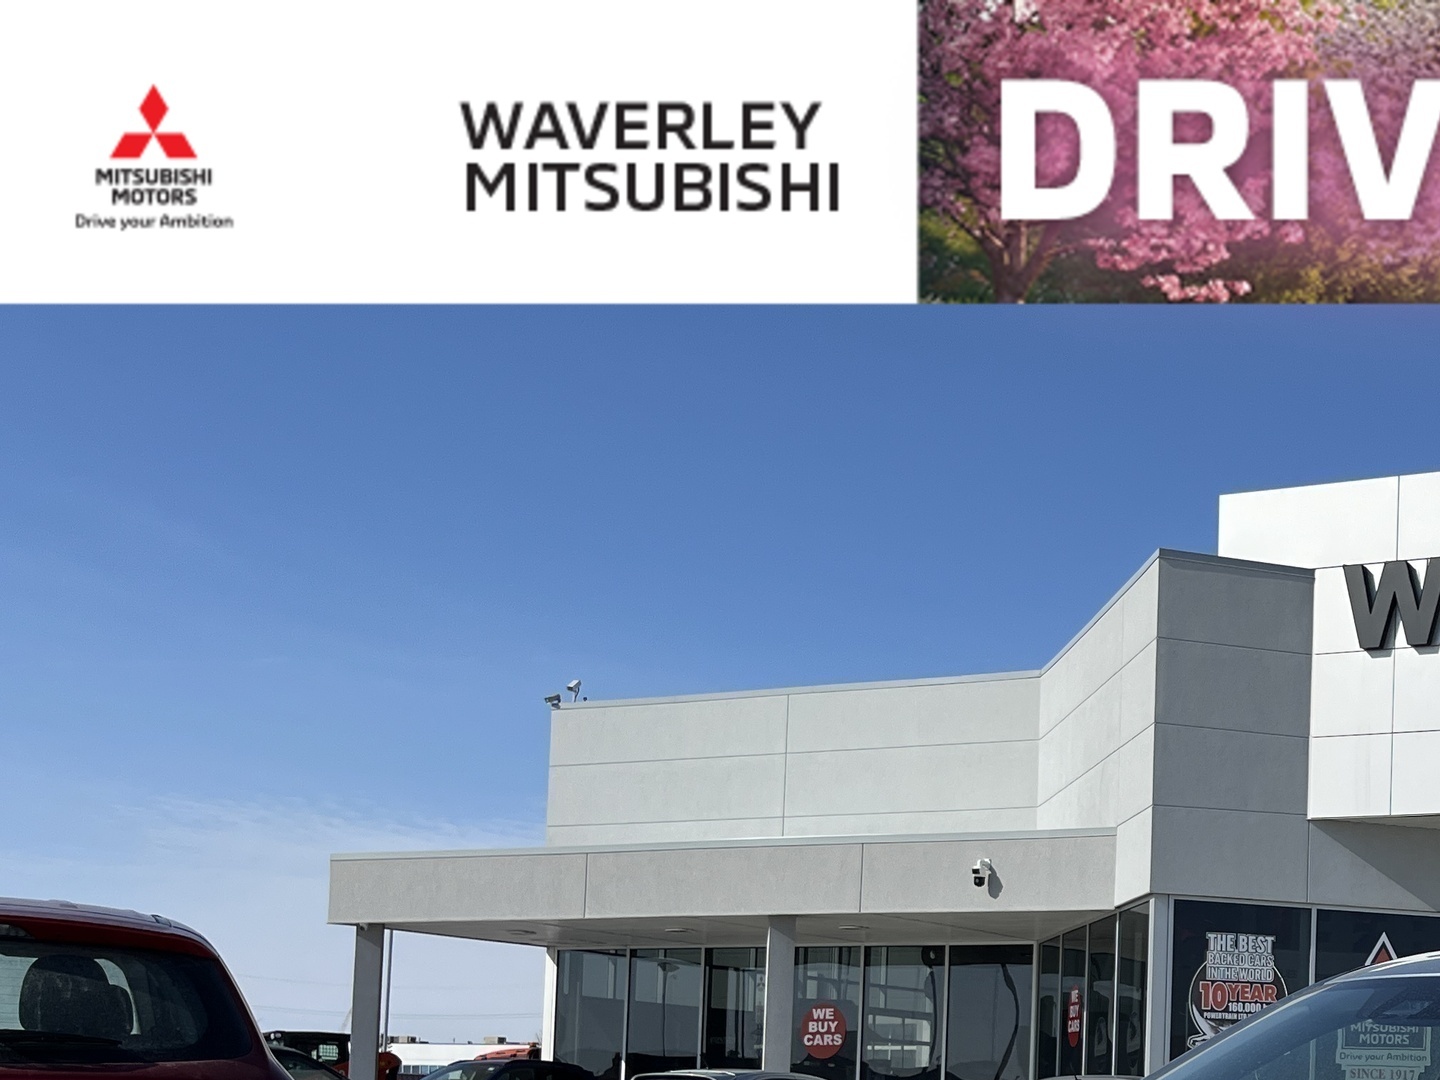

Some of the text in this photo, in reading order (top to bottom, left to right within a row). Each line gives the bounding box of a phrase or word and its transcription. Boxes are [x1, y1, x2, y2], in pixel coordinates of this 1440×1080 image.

[1207, 933, 1275, 955] THE BEST
[1207, 951, 1274, 967] BACKED CARS
[1208, 966, 1274, 982] IN THE WORLD
[1200, 981, 1277, 1011] 10 YEAR
[812, 1008, 835, 1020] WE
[808, 1021, 839, 1033] BUY
[1350, 1022, 1419, 1034] MITSUBISHI
[803, 1034, 843, 1046] CARS
[1359, 1033, 1410, 1045] MOTORS
[1339, 1052, 1428, 1063] Drive your Ambition
[1350, 1068, 1415, 1080] SINCE 1917
